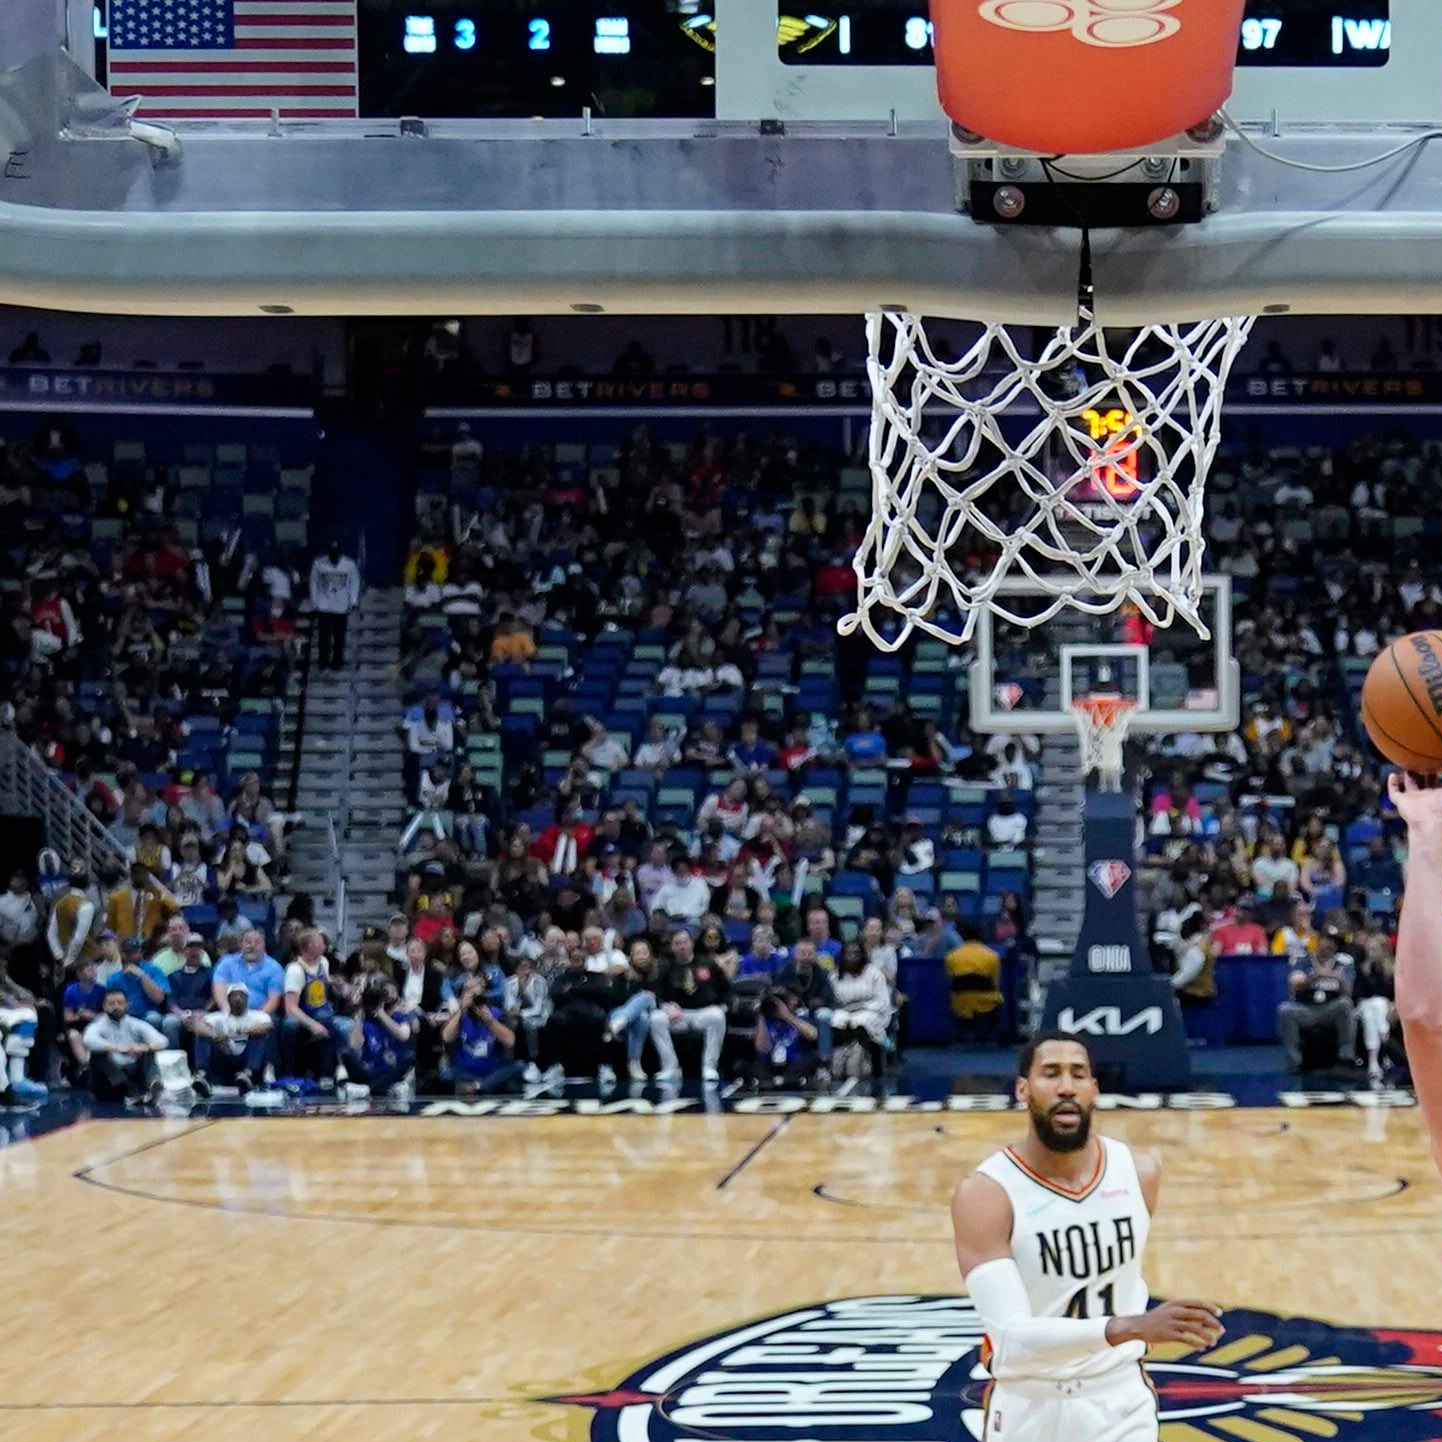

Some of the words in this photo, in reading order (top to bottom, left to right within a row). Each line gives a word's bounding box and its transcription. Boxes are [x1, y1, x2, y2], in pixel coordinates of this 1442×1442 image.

[904, 17, 935, 50] 8
[1241, 18, 1282, 50] 97
[29, 375, 214, 398] BETRIVERS
[531, 379, 712, 400] BETRIVERS
[1246, 377, 1425, 397] BETRIVERS
[1071, 944, 1123, 974] @NBA
[420, 1098, 703, 1116] NEW
[733, 1095, 1236, 1113] ORLENS
[1035, 1216, 1136, 1280] NOLA
